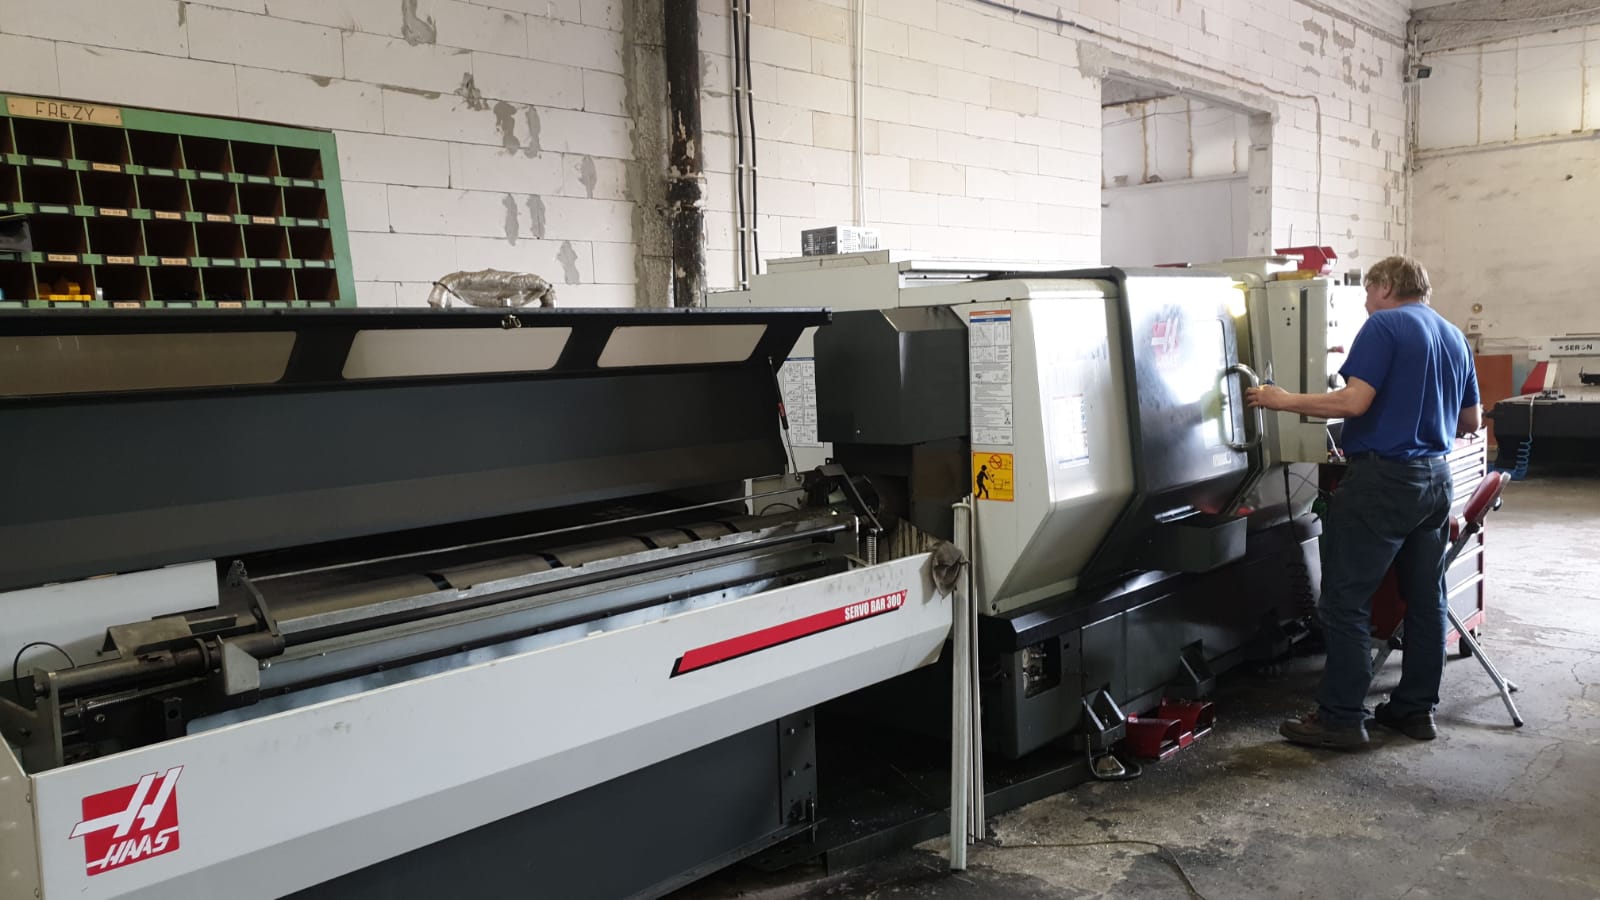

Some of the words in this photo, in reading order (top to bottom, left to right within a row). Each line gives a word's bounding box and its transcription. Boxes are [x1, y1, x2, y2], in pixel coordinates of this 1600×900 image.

[35, 101, 95, 121] FREZY
[844, 601, 870, 621] SERVO
[870, 597, 886, 613] BAR
[886, 593, 902, 609] 300
[96, 830, 173, 869] HAAS
